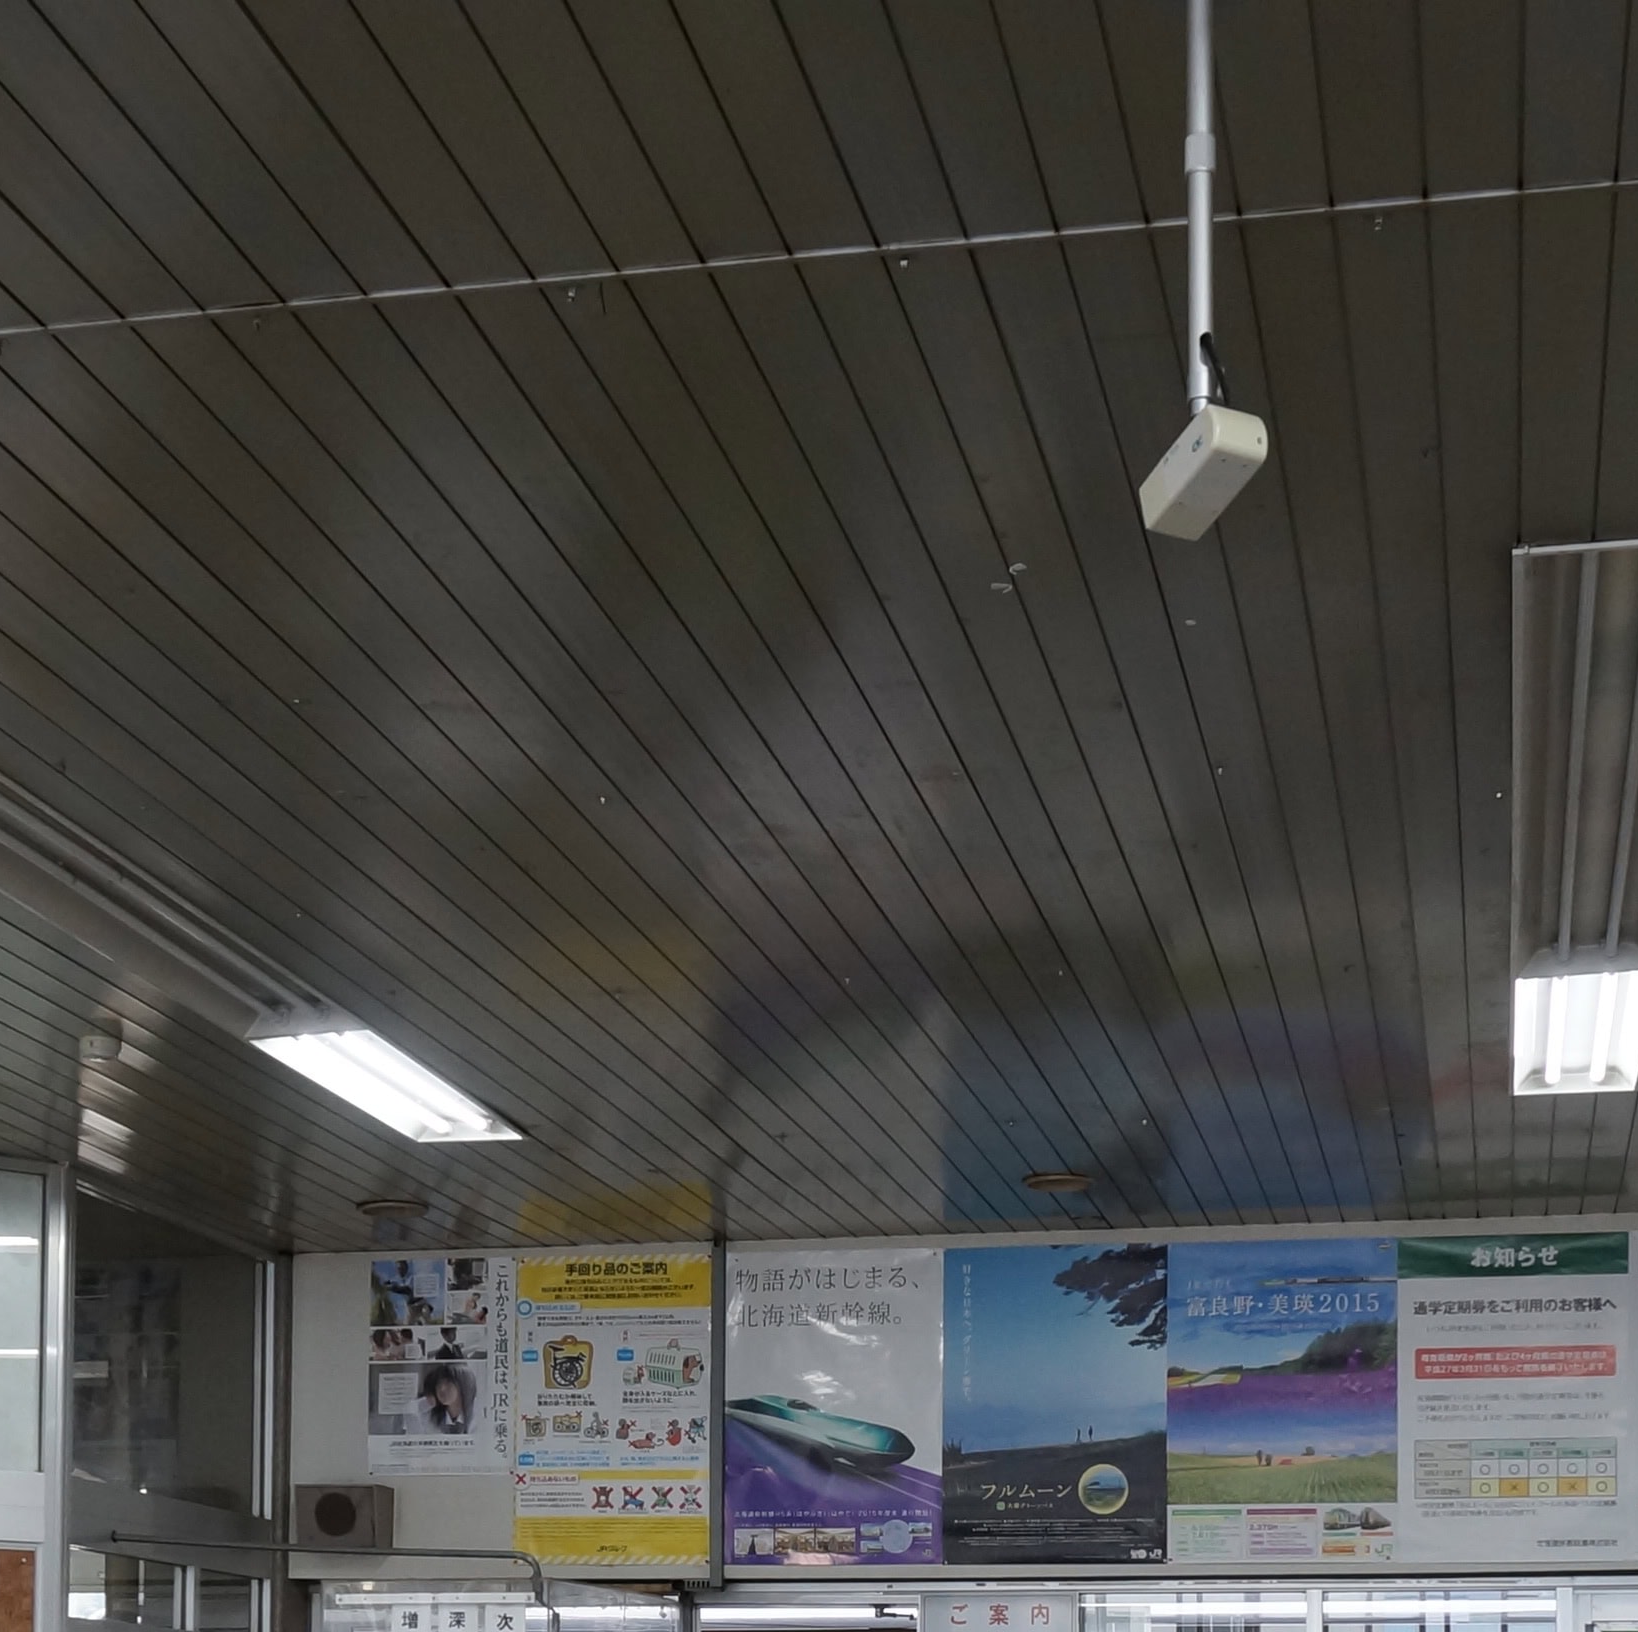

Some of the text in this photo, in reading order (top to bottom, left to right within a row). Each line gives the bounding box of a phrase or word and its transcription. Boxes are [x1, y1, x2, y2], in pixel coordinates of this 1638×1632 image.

[1470, 1244, 1559, 1269] お知らせ
[565, 1262, 668, 1276] 手回り品のご案内
[735, 1265, 921, 1294] 物語がはじまる、
[737, 1302, 904, 1329] 北海道新幹線。
[1413, 1297, 1617, 1316] 通学定期券をご利用のお客様へ
[493, 1263, 510, 1459] これからも道民は、JRに乗る。
[980, 1482, 1073, 1500] フルムーン
[950, 1602, 1050, 1626] ご案内
